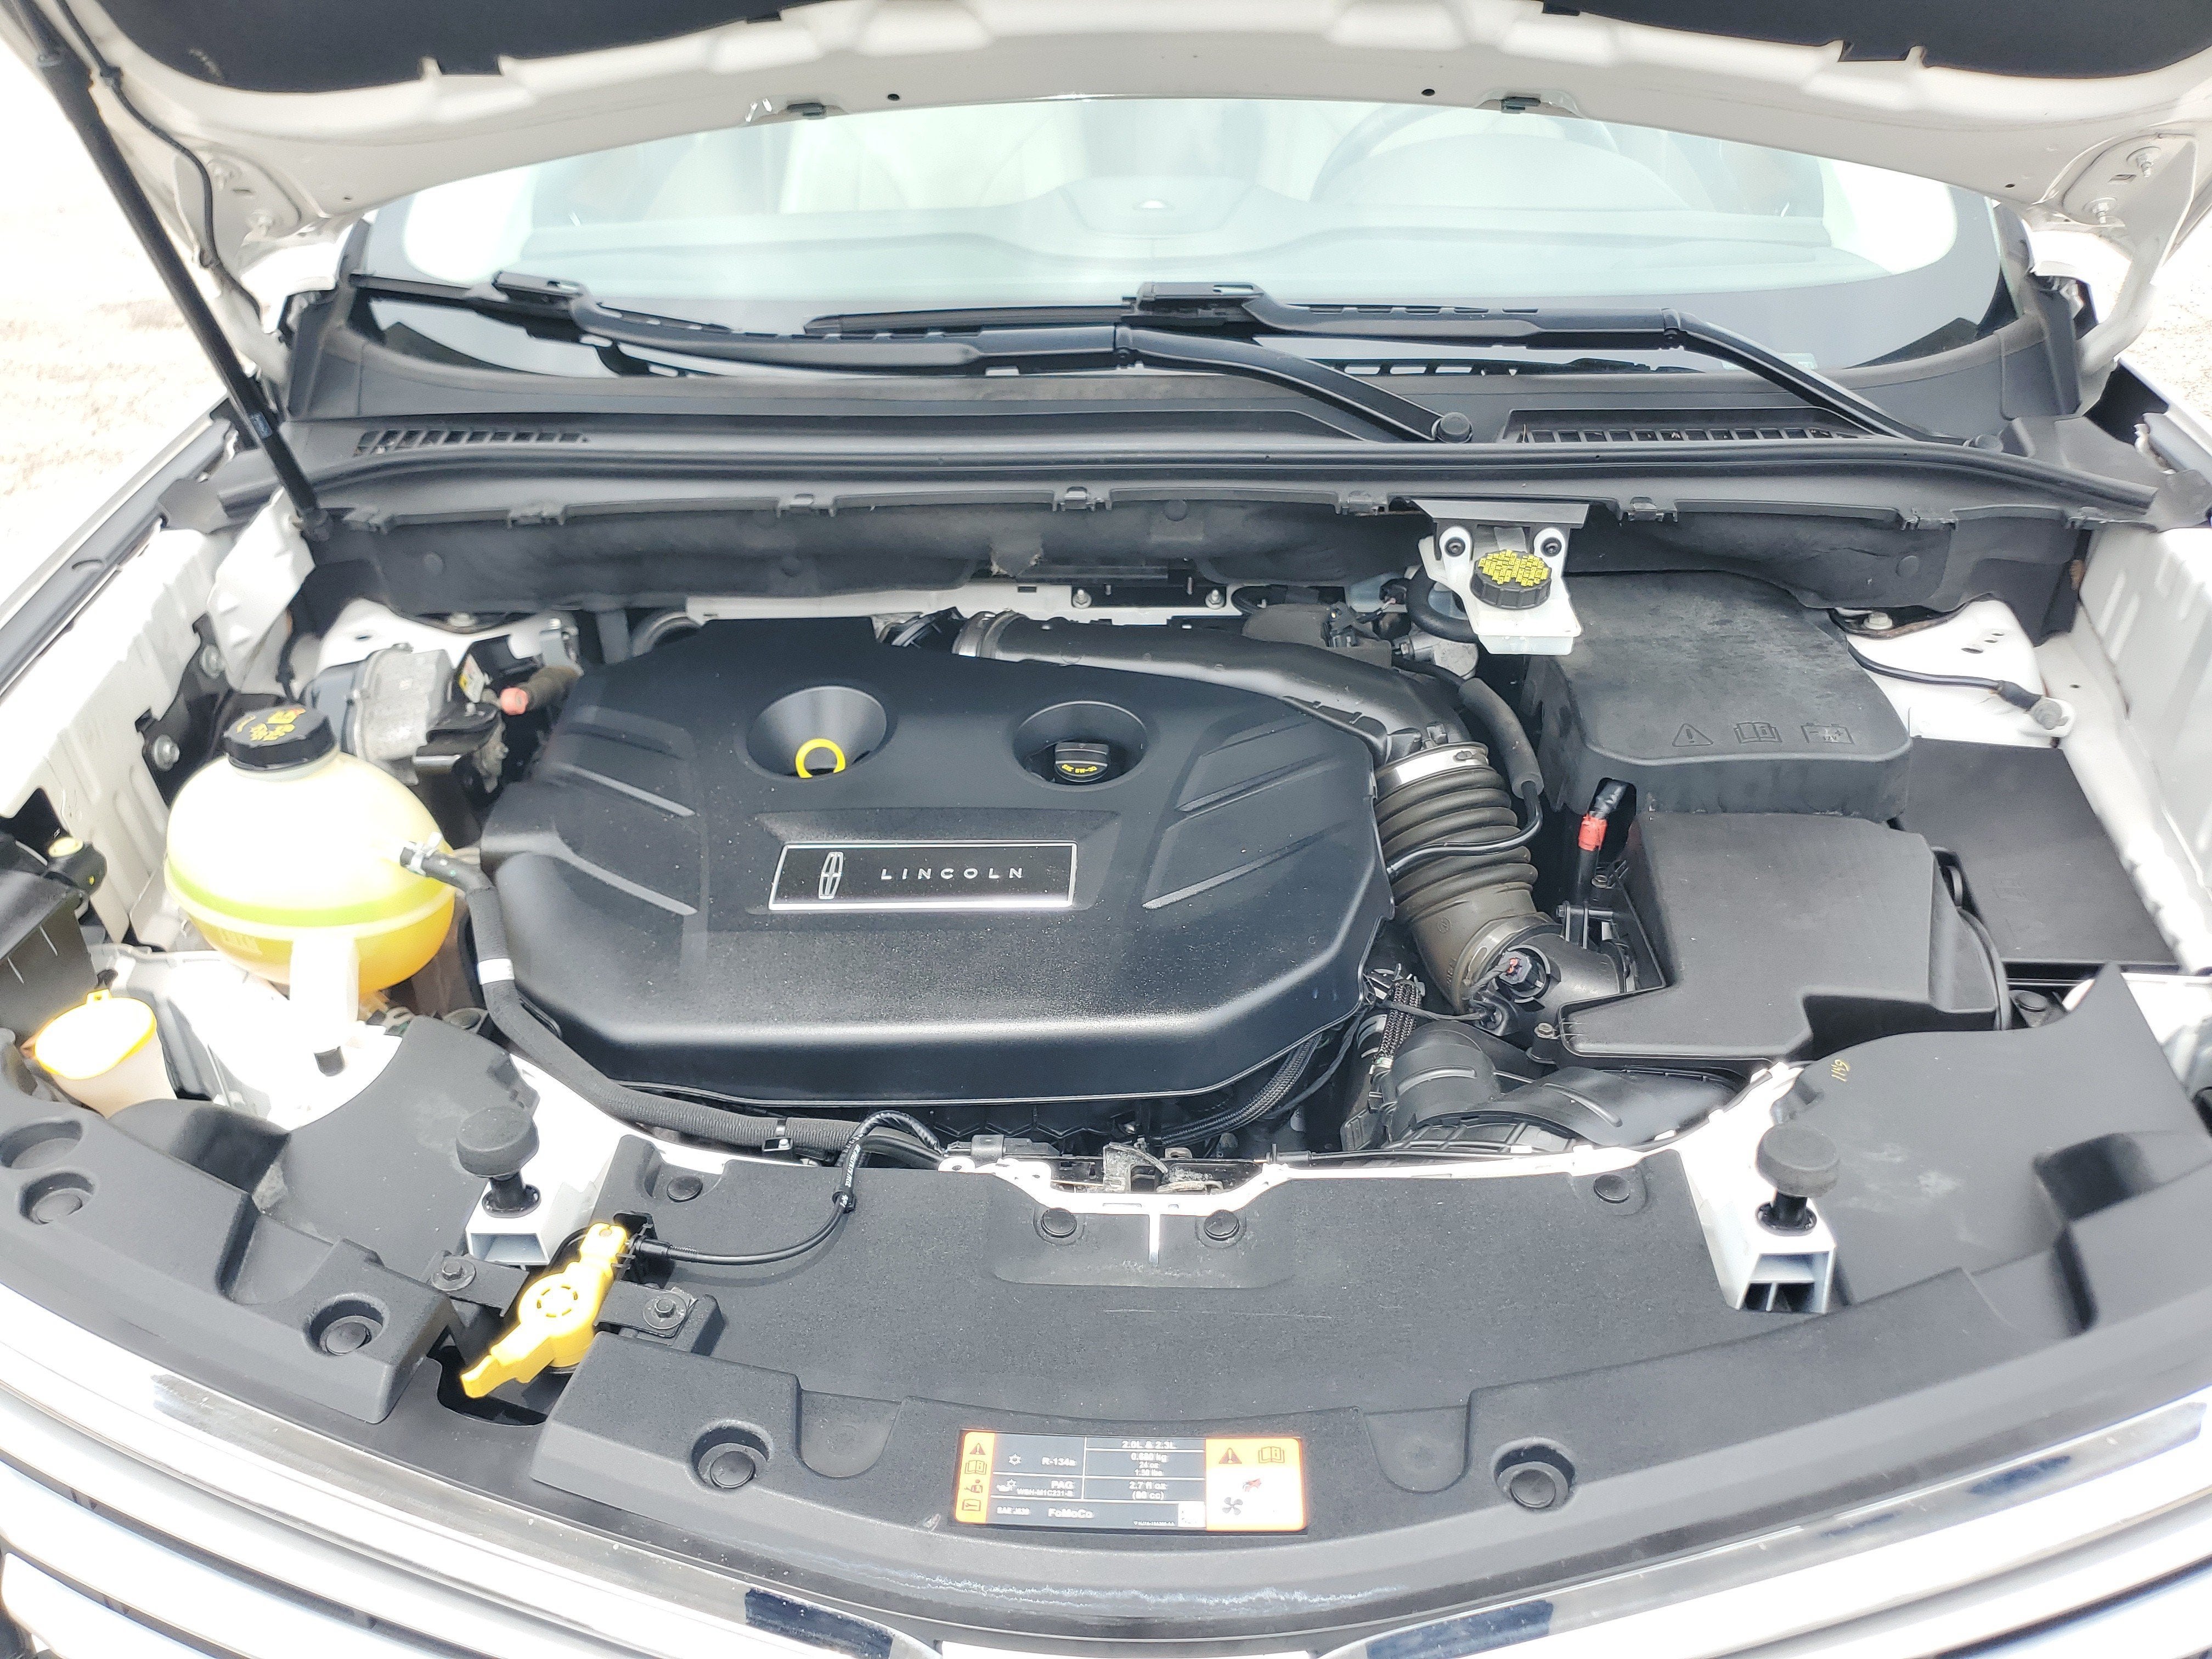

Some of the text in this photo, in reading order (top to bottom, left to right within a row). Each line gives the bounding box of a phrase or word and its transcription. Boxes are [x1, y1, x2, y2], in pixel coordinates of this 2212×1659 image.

[881, 867, 1023, 880] LINCOLN
[1042, 1457, 1077, 1466] R-134a
[1156, 1452, 1167, 1463] kg
[1051, 1480, 1074, 1489] PAG
[1129, 1481, 1143, 1489] 2.7
[1048, 1507, 1093, 1519] FoMoCo
